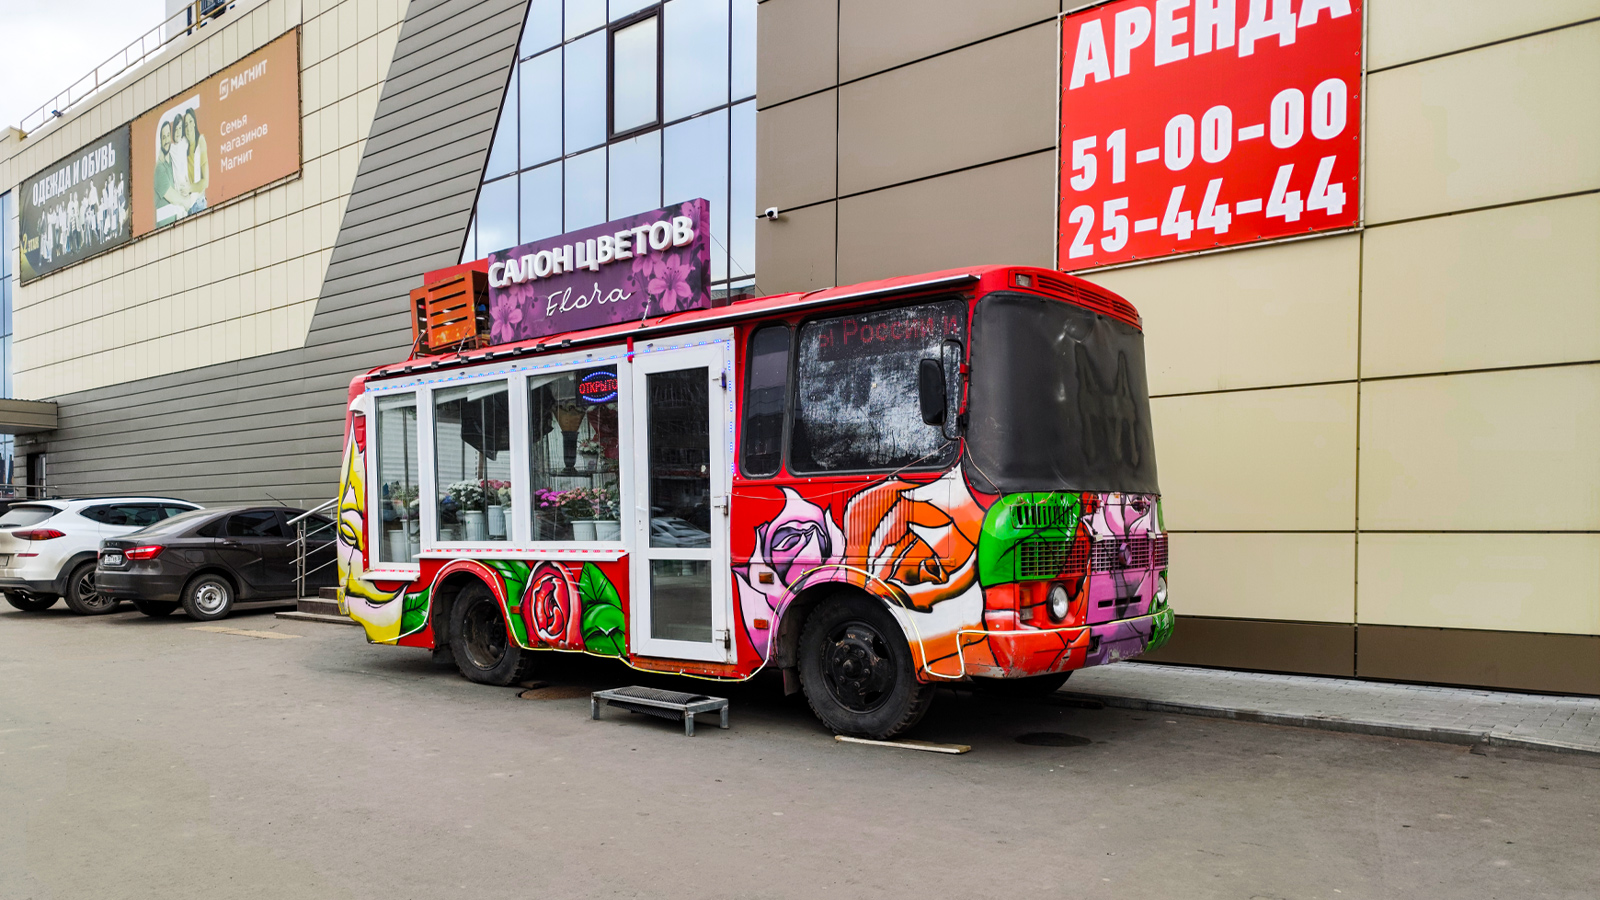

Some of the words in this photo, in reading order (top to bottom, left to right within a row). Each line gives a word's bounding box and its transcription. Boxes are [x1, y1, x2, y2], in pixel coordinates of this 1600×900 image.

[230, 59, 268, 92] МАГНИТ
[220, 114, 248, 136] Семья
[220, 123, 268, 155] магазинов
[1070, 78, 1347, 192] 51-00-00
[32, 165, 72, 208] ОДЕЖДА
[73, 160, 80, 185] И
[81, 142, 116, 181] ОБУВЬ
[220, 149, 253, 173] Магнит
[1068, 155, 1347, 259] 25-44-44
[488, 244, 574, 288] САЛОН
[575, 216, 695, 272] ЦВЕТОВ
[546, 281, 633, 316] Flora
[842, 317, 934, 345] России
[578, 378, 618, 395] ОТКРЫТО
